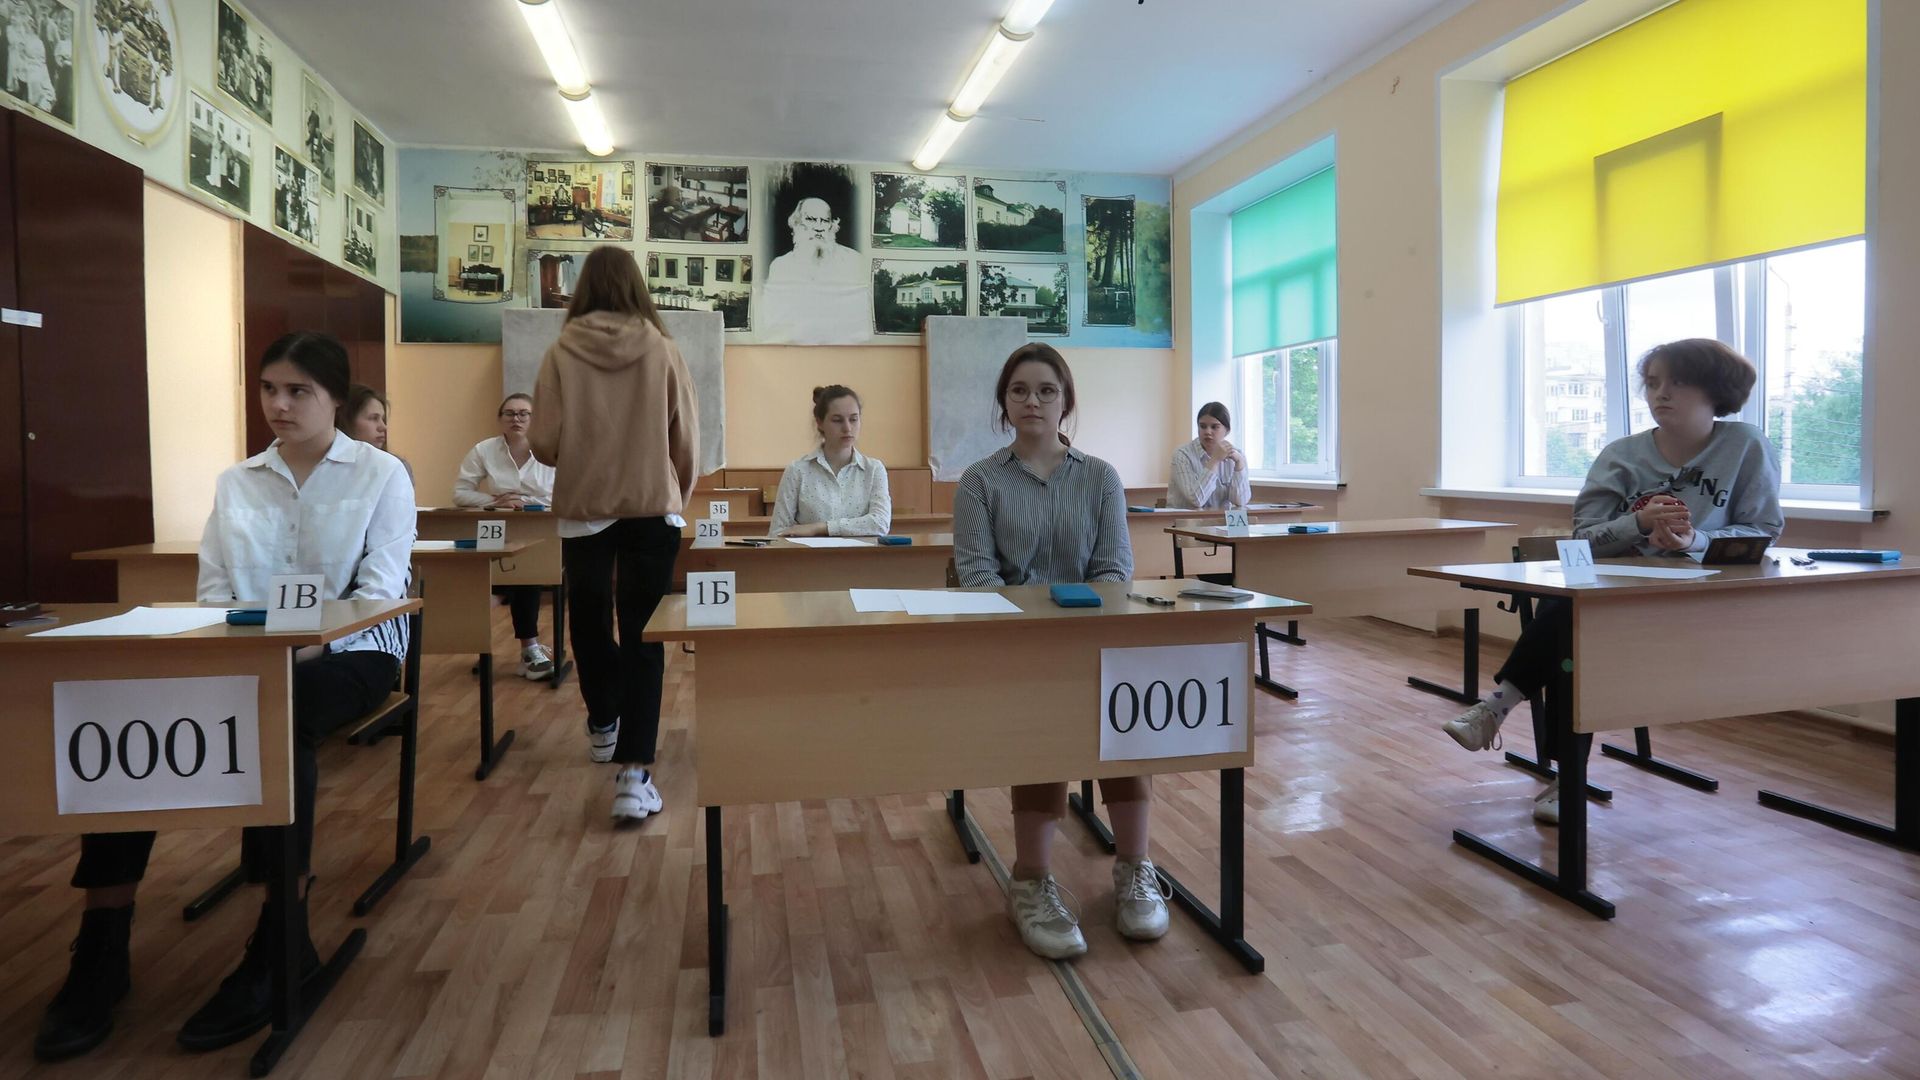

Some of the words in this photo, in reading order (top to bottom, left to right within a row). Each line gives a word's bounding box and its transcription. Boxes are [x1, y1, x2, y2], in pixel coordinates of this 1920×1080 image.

[712, 504, 727, 514] 3Б
[1228, 514, 1246, 526] 2А
[480, 525, 503, 539] 2В
[699, 523, 719, 537] 2Б
[1563, 548, 1590, 567] 1А
[276, 583, 317, 610] 1В
[696, 580, 730, 605] 1Б
[1108, 676, 1234, 733] 0001
[68, 715, 245, 782] 0001
